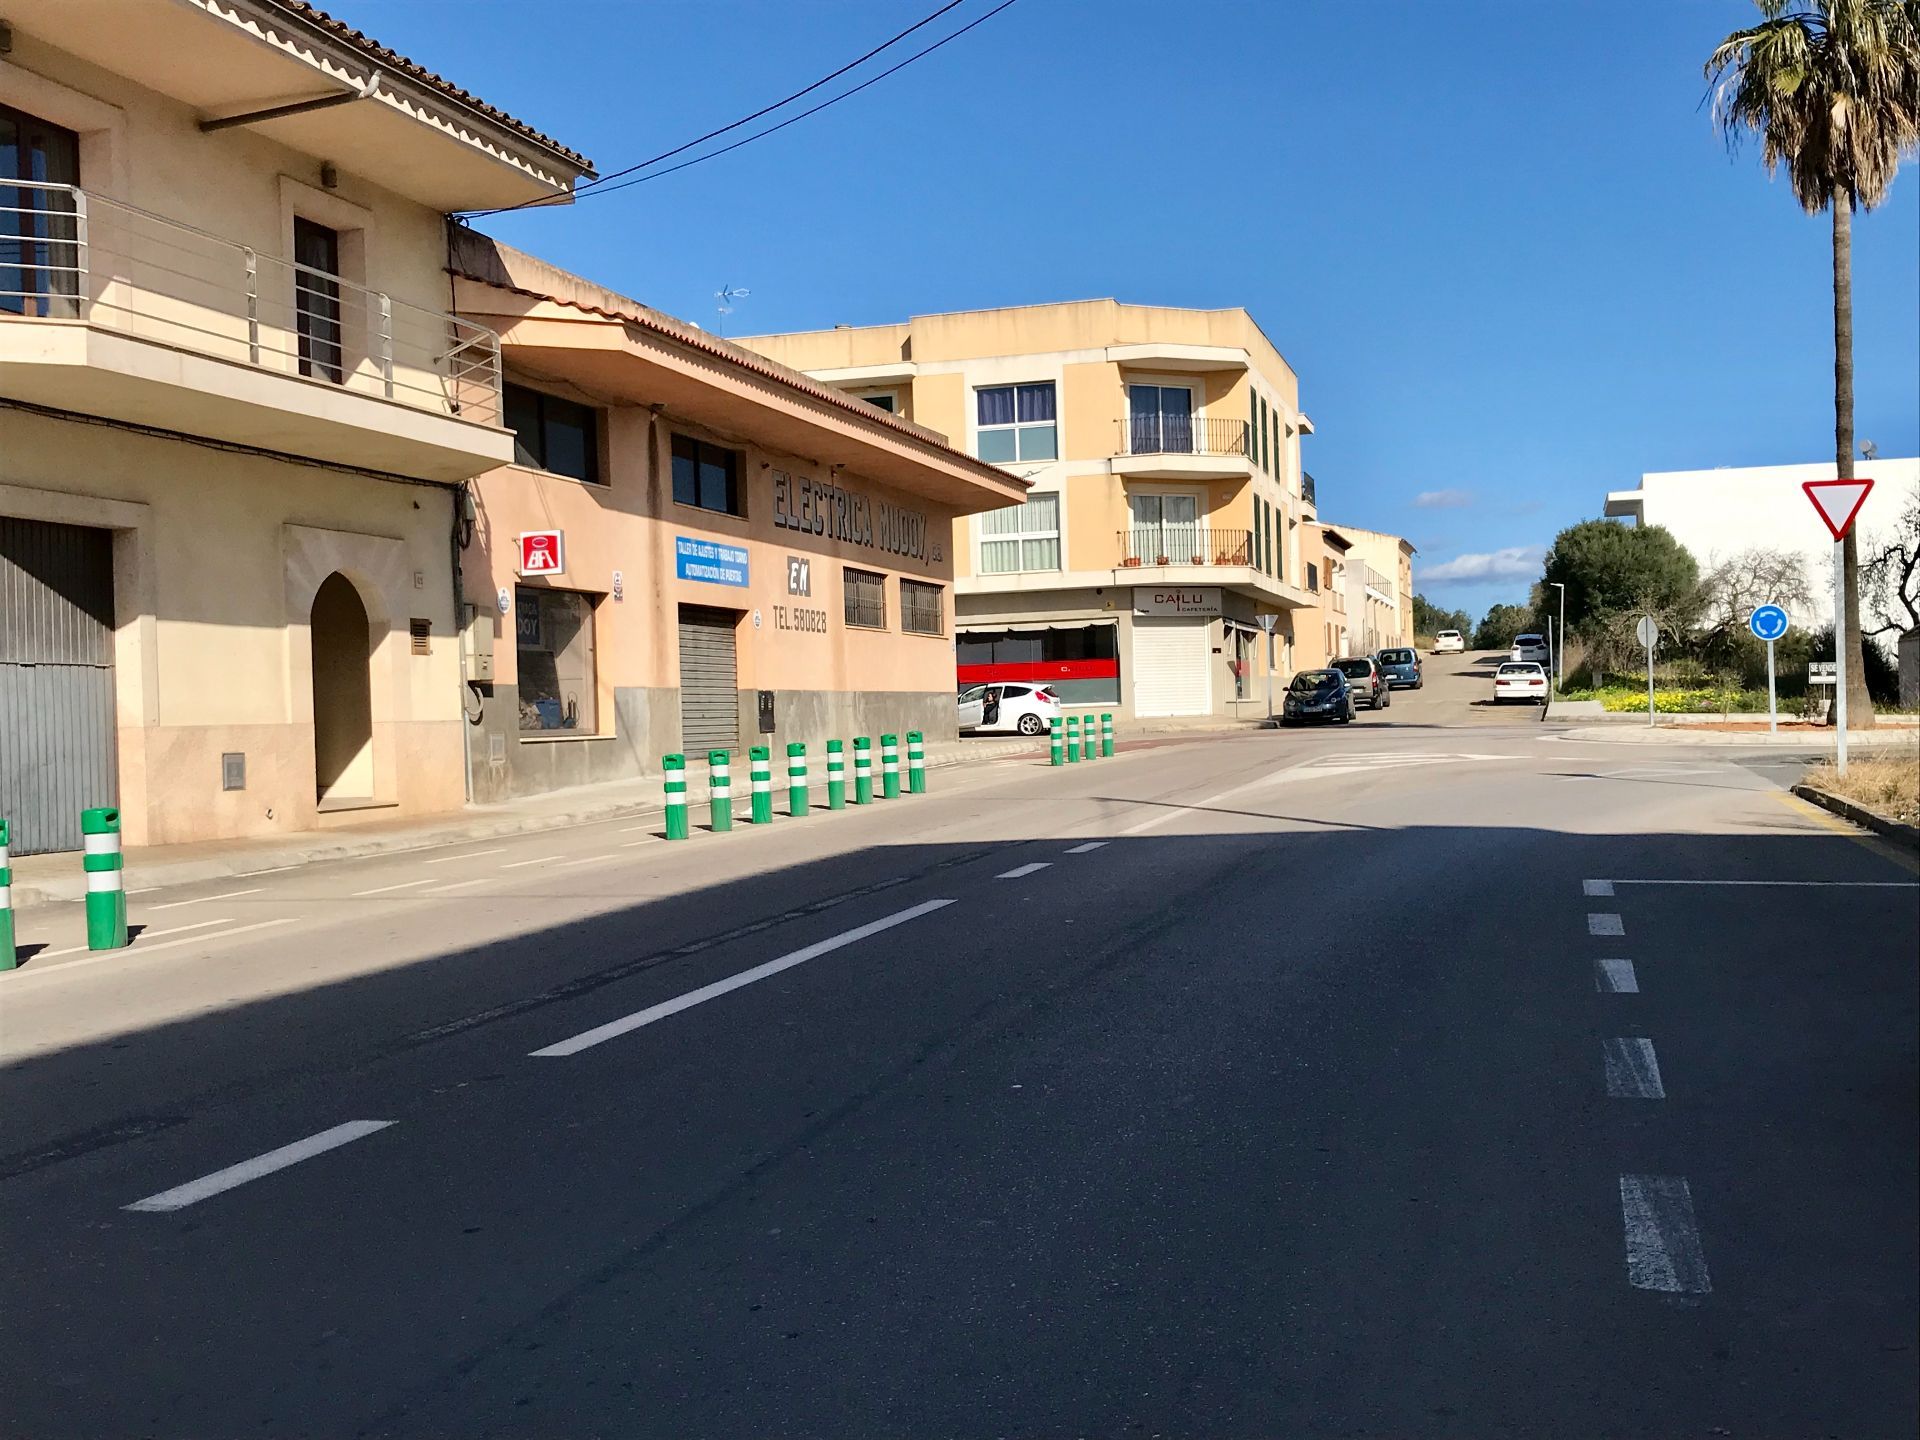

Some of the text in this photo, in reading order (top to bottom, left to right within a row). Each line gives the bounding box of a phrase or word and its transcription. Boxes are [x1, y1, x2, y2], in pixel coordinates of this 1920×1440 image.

[772, 469, 874, 548] ELECTRICA
[677, 541, 692, 555] TALLER
[692, 543, 698, 556] DE
[718, 548, 734, 562] TRABAJO
[720, 567, 726, 580] DE
